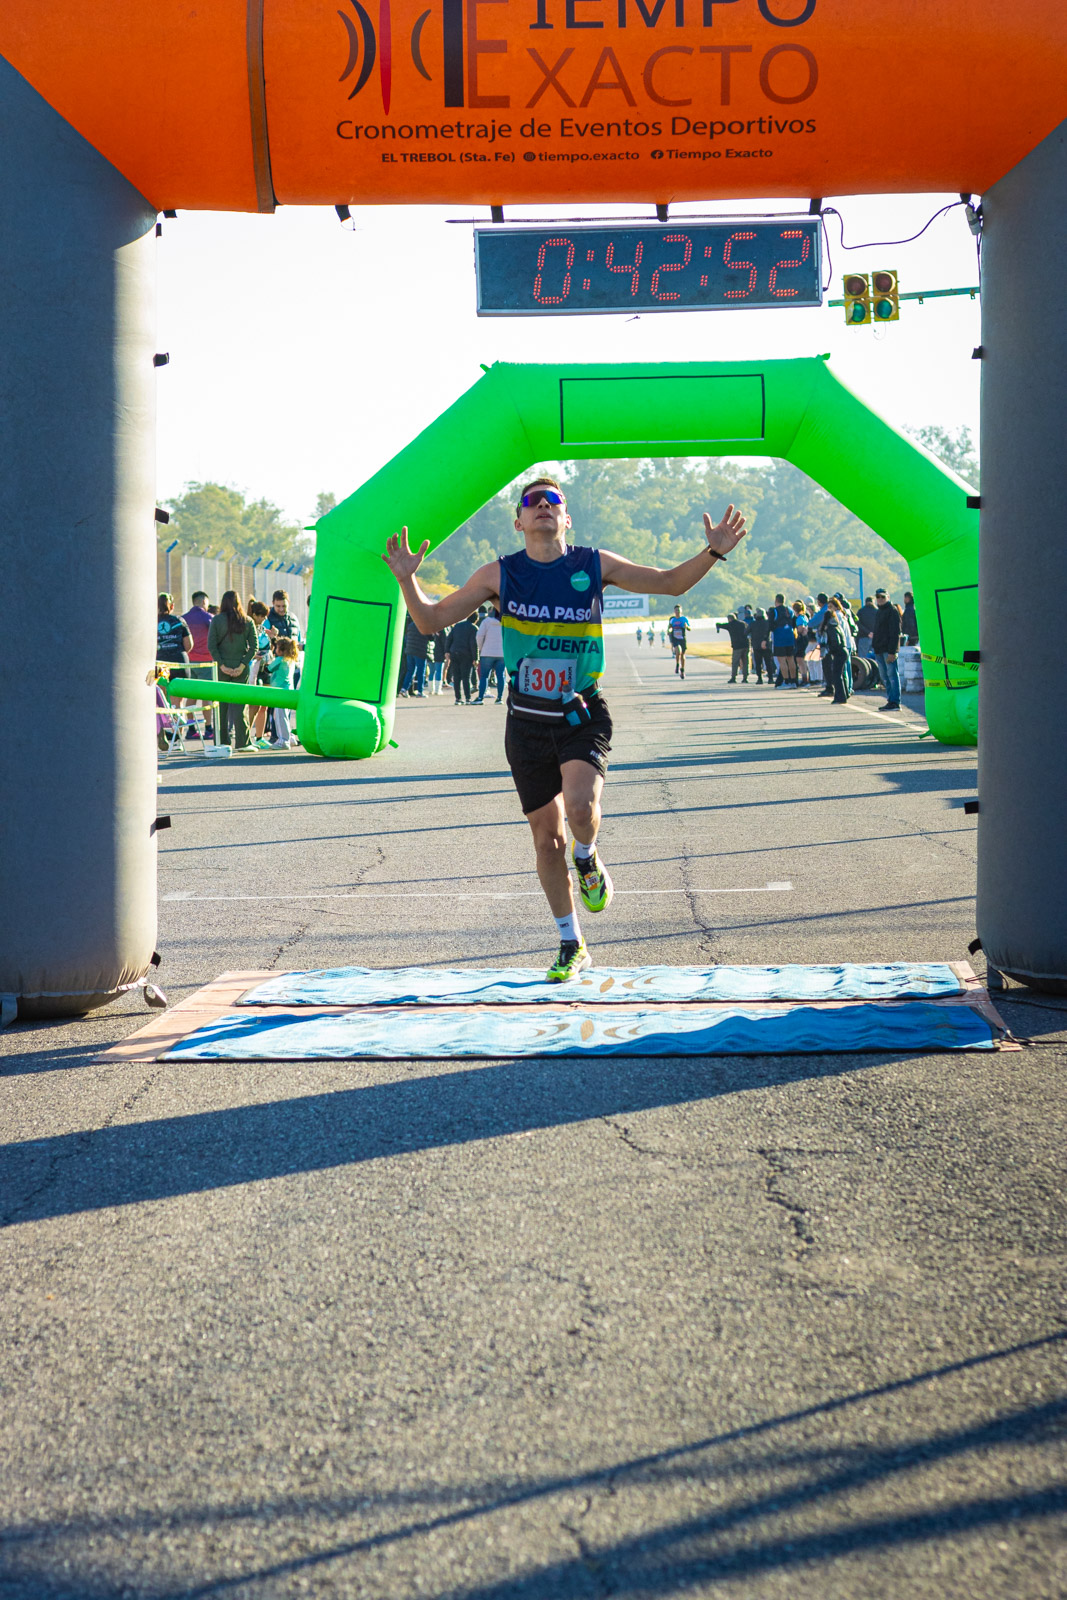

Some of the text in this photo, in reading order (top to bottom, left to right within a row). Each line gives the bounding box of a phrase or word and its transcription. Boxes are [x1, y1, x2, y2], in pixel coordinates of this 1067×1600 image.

[337, 115, 817, 143] Cronometraje de Eventos Deportivos
[381, 152, 398, 163] EL
[400, 152, 456, 163] TREBOL
[459, 151, 491, 164] (Sta.
[494, 151, 516, 164] Fe)
[666, 149, 722, 161] Tiempo
[725, 148, 774, 159] Exacto
[533, 230, 810, 304] 0:42:52
[507, 600, 592, 621] CADA PASO
[537, 637, 600, 654] CUENTA
[531, 668, 566, 693] 301
